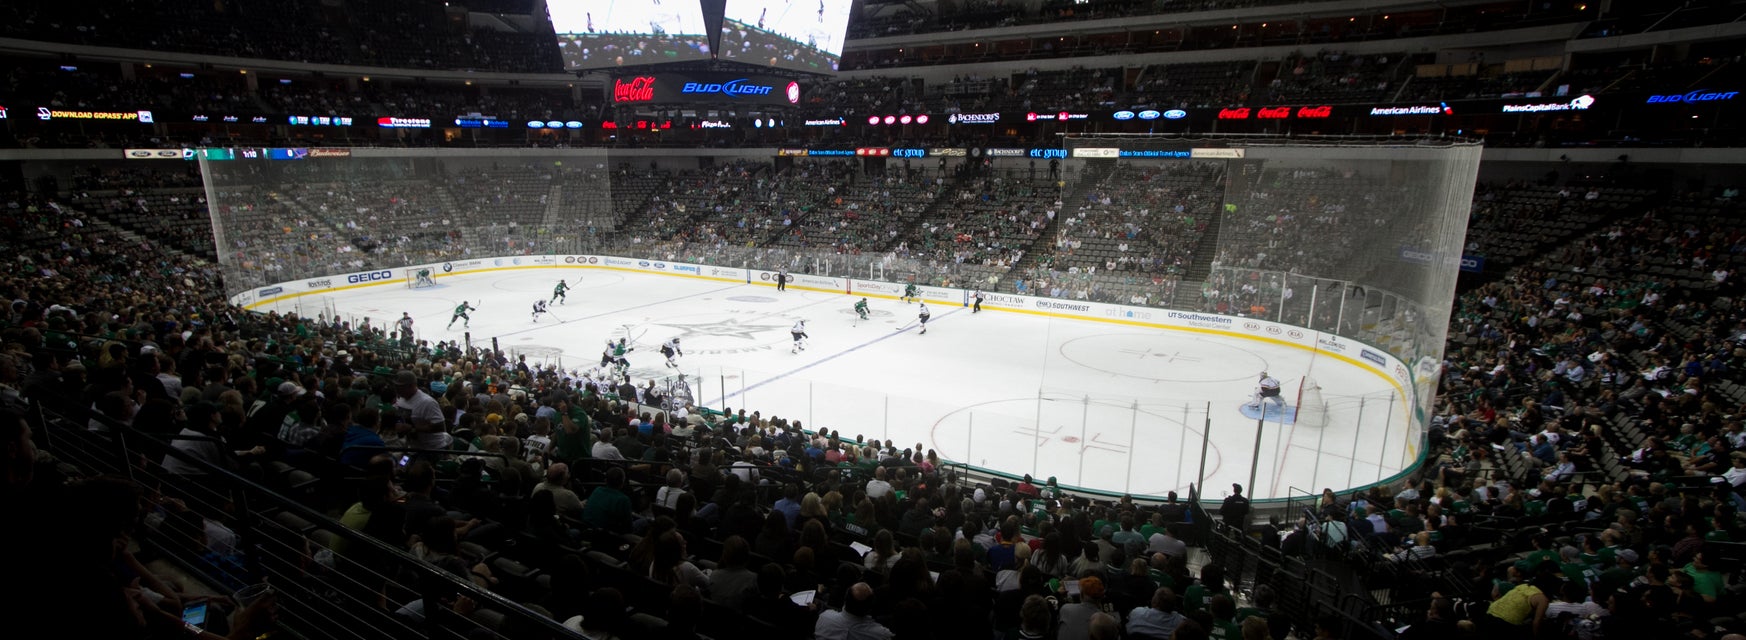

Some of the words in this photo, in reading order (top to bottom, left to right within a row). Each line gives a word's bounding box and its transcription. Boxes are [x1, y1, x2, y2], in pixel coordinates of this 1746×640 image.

[614, 76, 656, 102] Coca-Cola
[682, 83, 722, 93] BUD
[728, 83, 772, 95] LIGHT
[1646, 95, 1682, 103] BUD
[1688, 92, 1739, 101] LIGHT
[51, 110, 93, 119] DOWNLOAD
[93, 111, 121, 119] GOPASS
[122, 112, 138, 120] APP
[1218, 108, 1250, 119] Coca-Cola
[1257, 107, 1290, 118] Coca-Cola
[1297, 106, 1331, 118] Coca-Cola
[1370, 107, 1409, 115] American
[1409, 106, 1440, 114] Airlines
[957, 113, 1000, 122] BACHENDORF'S
[904, 149, 924, 158] group
[1030, 148, 1043, 156] etc
[1043, 149, 1068, 158] group
[348, 270, 392, 284] GEICO
[984, 294, 1024, 304] CHOCTAW
[1052, 303, 1090, 312] SOUTHWEST
[1178, 312, 1232, 325] Southwestern
